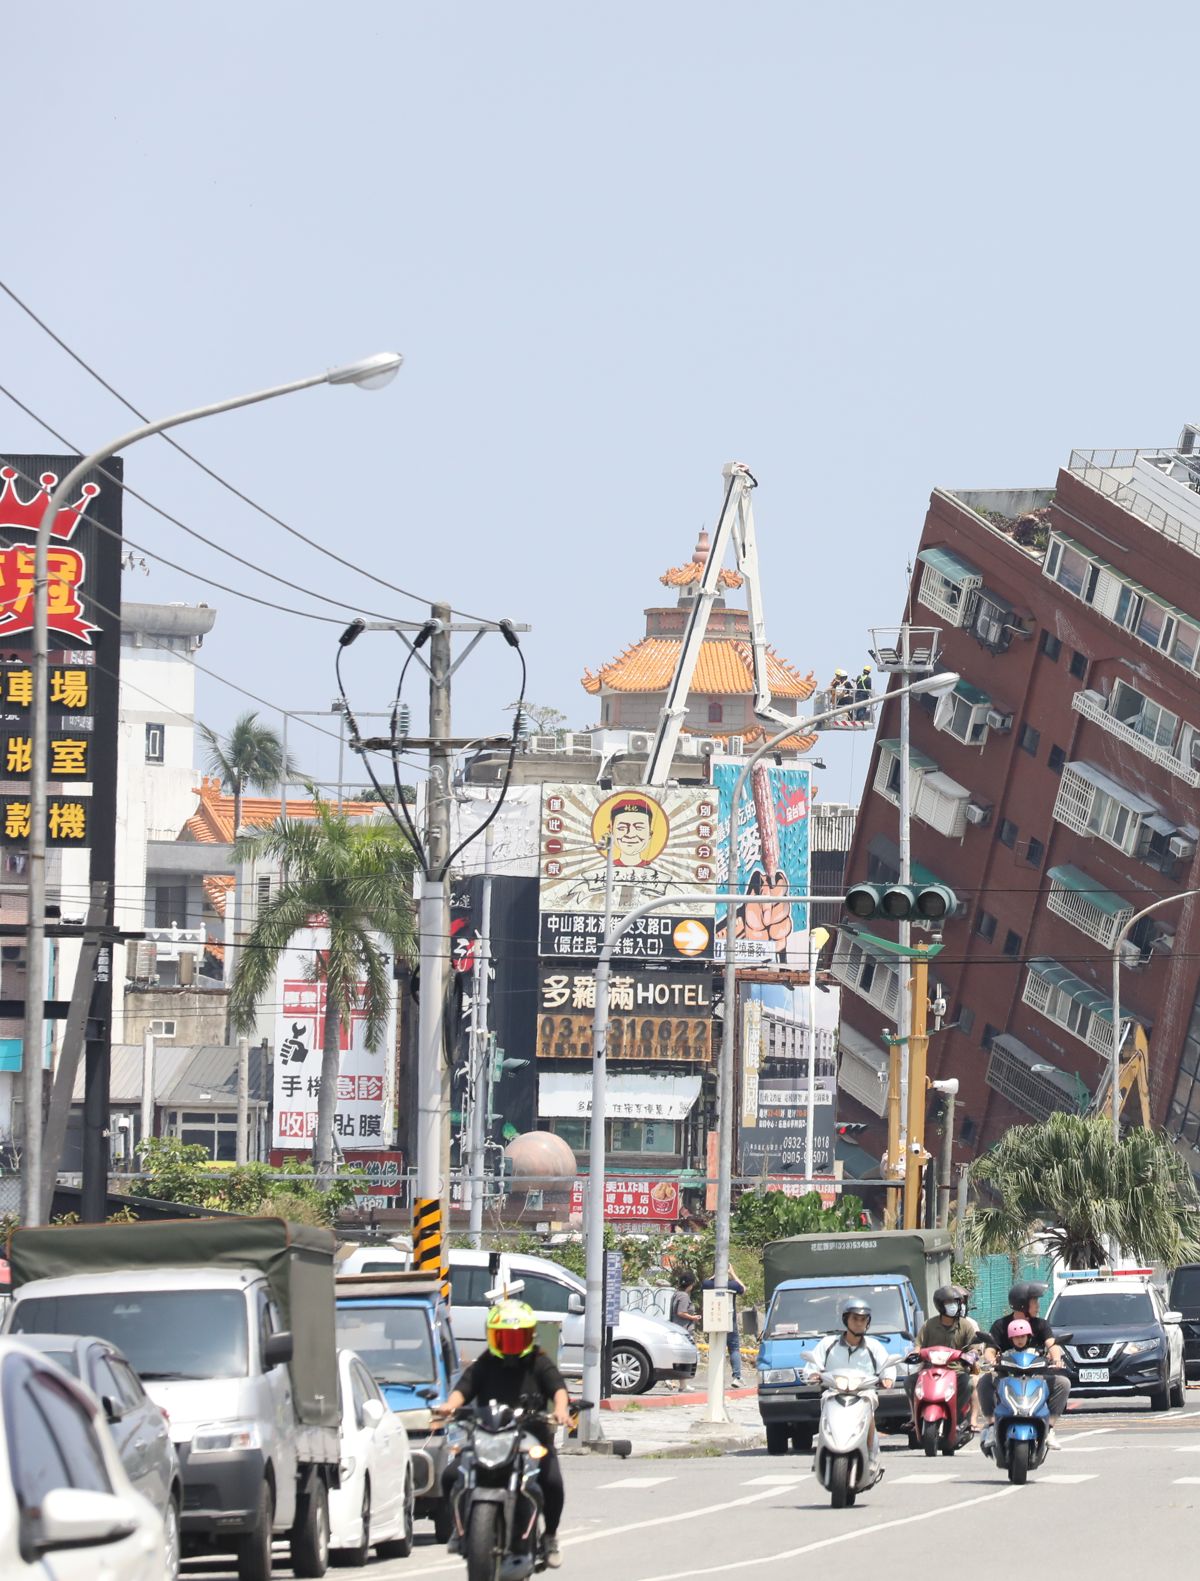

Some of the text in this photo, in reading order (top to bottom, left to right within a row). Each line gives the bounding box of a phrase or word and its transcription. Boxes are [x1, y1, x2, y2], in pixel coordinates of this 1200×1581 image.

[0, 552, 78, 616] 冠
[0, 669, 88, 708] 車場
[548, 799, 562, 875] 僅此一家
[697, 804, 711, 881] 別無分號
[637, 983, 709, 1006] HOTEL
[541, 1016, 707, 1043] 03-316622
[782, 1151, 829, 1164] 0905-95071
[783, 1136, 830, 1150] 0932-91018
